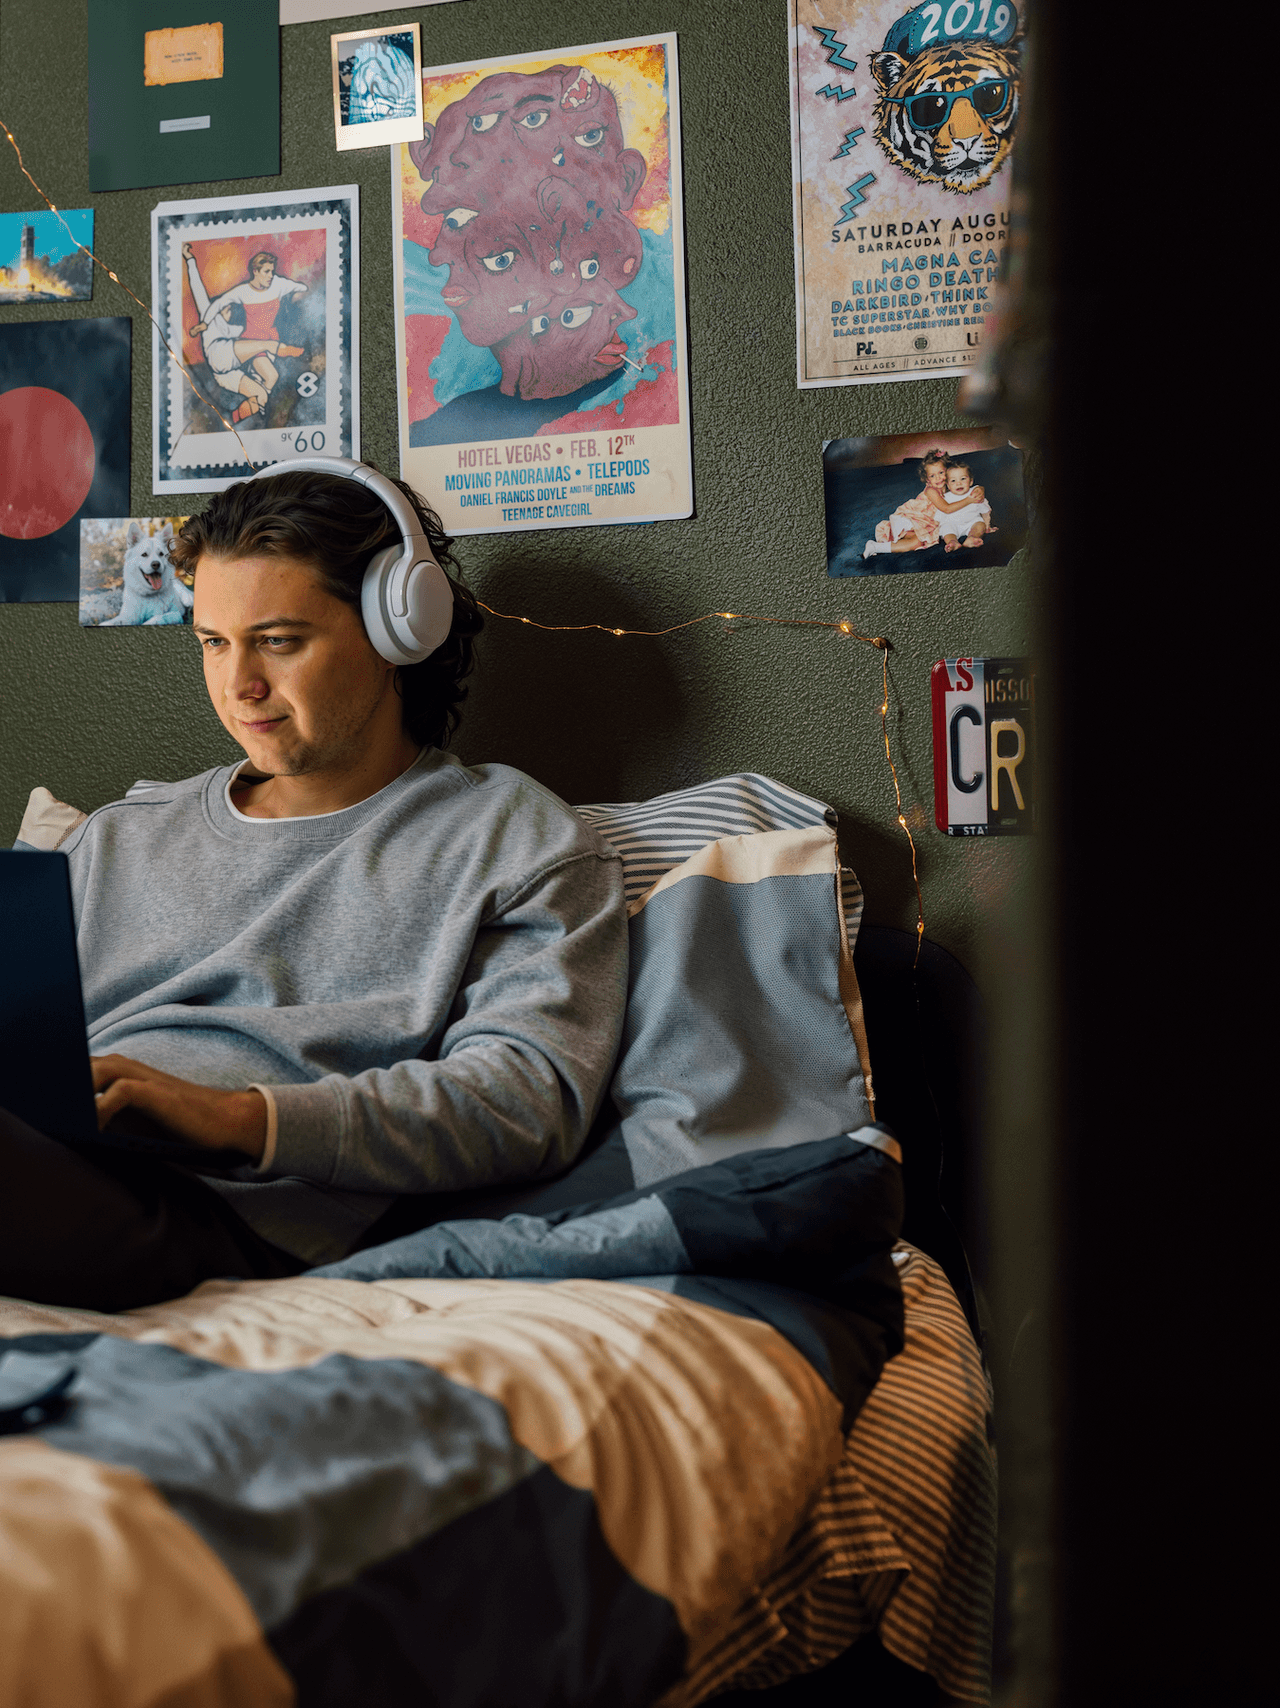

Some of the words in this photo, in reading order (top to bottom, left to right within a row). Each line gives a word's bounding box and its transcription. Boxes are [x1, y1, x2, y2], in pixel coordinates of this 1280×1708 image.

[920, 0, 1010, 46] 2019
[831, 218, 942, 243] SATURDAY
[858, 236, 942, 254] BARRACUDA
[882, 251, 960, 274] MAGNA
[969, 249, 998, 265] CA
[852, 274, 920, 296] RINGO
[929, 266, 1000, 288] DEATH
[831, 292, 922, 314] DARKBIRD
[930, 286, 989, 304] THINK
[831, 316, 849, 327] TC
[852, 307, 931, 326] SUPERSTAR
[935, 303, 968, 317] WHY
[833, 326, 866, 338] BLACK
[868, 323, 903, 335] BOOKS
[906, 317, 961, 331] CHRISTINE
[853, 363, 869, 372] ALL
[873, 361, 896, 370] AGES
[914, 355, 957, 367] ADVANCE
[294, 430, 326, 453] 60
[458, 447, 502, 468] HOTEL
[505, 442, 551, 464] VEGAS
[570, 438, 601, 459] FEB.
[445, 471, 492, 491] MOVING
[495, 465, 571, 487] PANORAMAS
[587, 458, 650, 479] TELEPODS
[460, 492, 494, 507] DANIEL
[495, 488, 535, 504] FRANCIS
[537, 486, 567, 501] DOYLE
[569, 485, 581, 494] AND
[582, 484, 594, 493] THE
[594, 481, 636, 497] DREAMS
[501, 505, 544, 522] TEENAGE
[546, 502, 592, 518] CAVEGIRL
